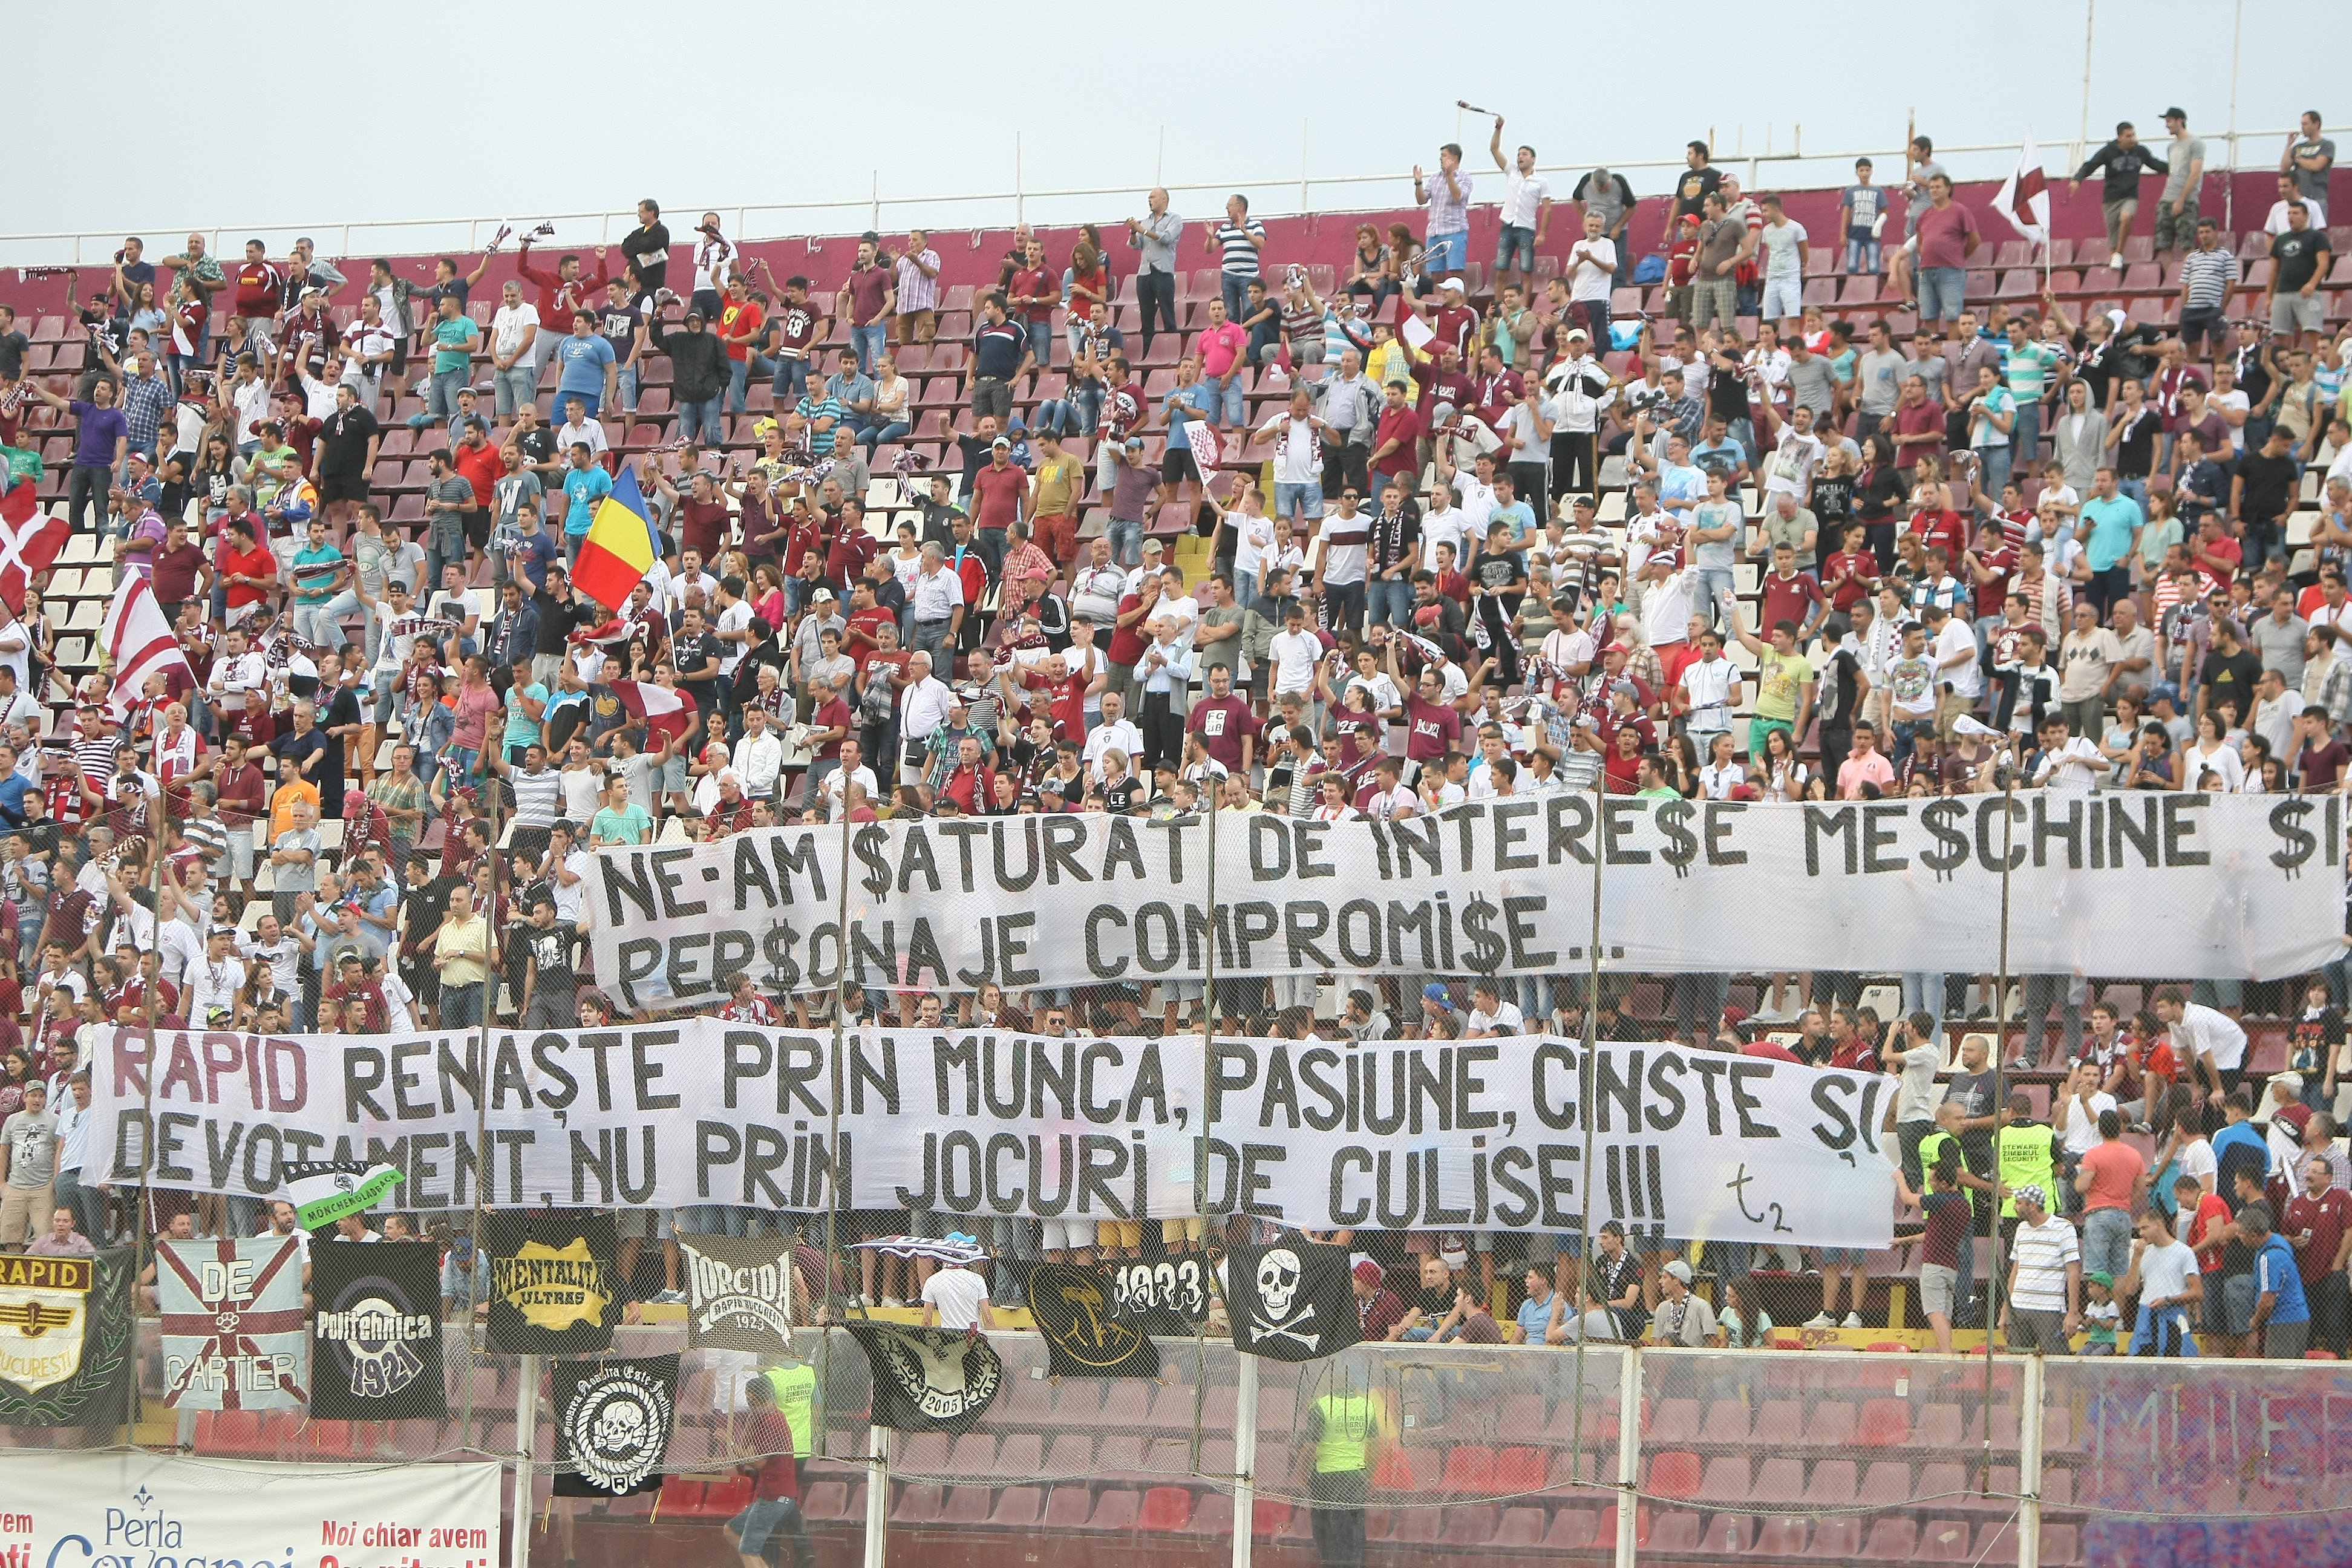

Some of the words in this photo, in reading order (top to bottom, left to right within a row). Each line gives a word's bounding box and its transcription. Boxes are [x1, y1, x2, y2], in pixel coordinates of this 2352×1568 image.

[1249, 814, 1335, 881] DE
[113, 1025, 308, 1113] RAPID
[1193, 1135, 1287, 1219] DE
[0, 1258, 79, 1287] RAPID
[201, 1259, 255, 1303] DE
[680, 1242, 792, 1321] TORCIDA
[520, 1290, 586, 1306] ULTRAS
[316, 1310, 434, 1342] Politehnica
[736, 1315, 765, 1331] 1923
[350, 1340, 424, 1399] 1921
[925, 1396, 958, 1414] 2005
[104, 1506, 184, 1549] Perla
[321, 1519, 358, 1546] Noi
[362, 1521, 422, 1548] chiar
[428, 1526, 488, 1549] avem
